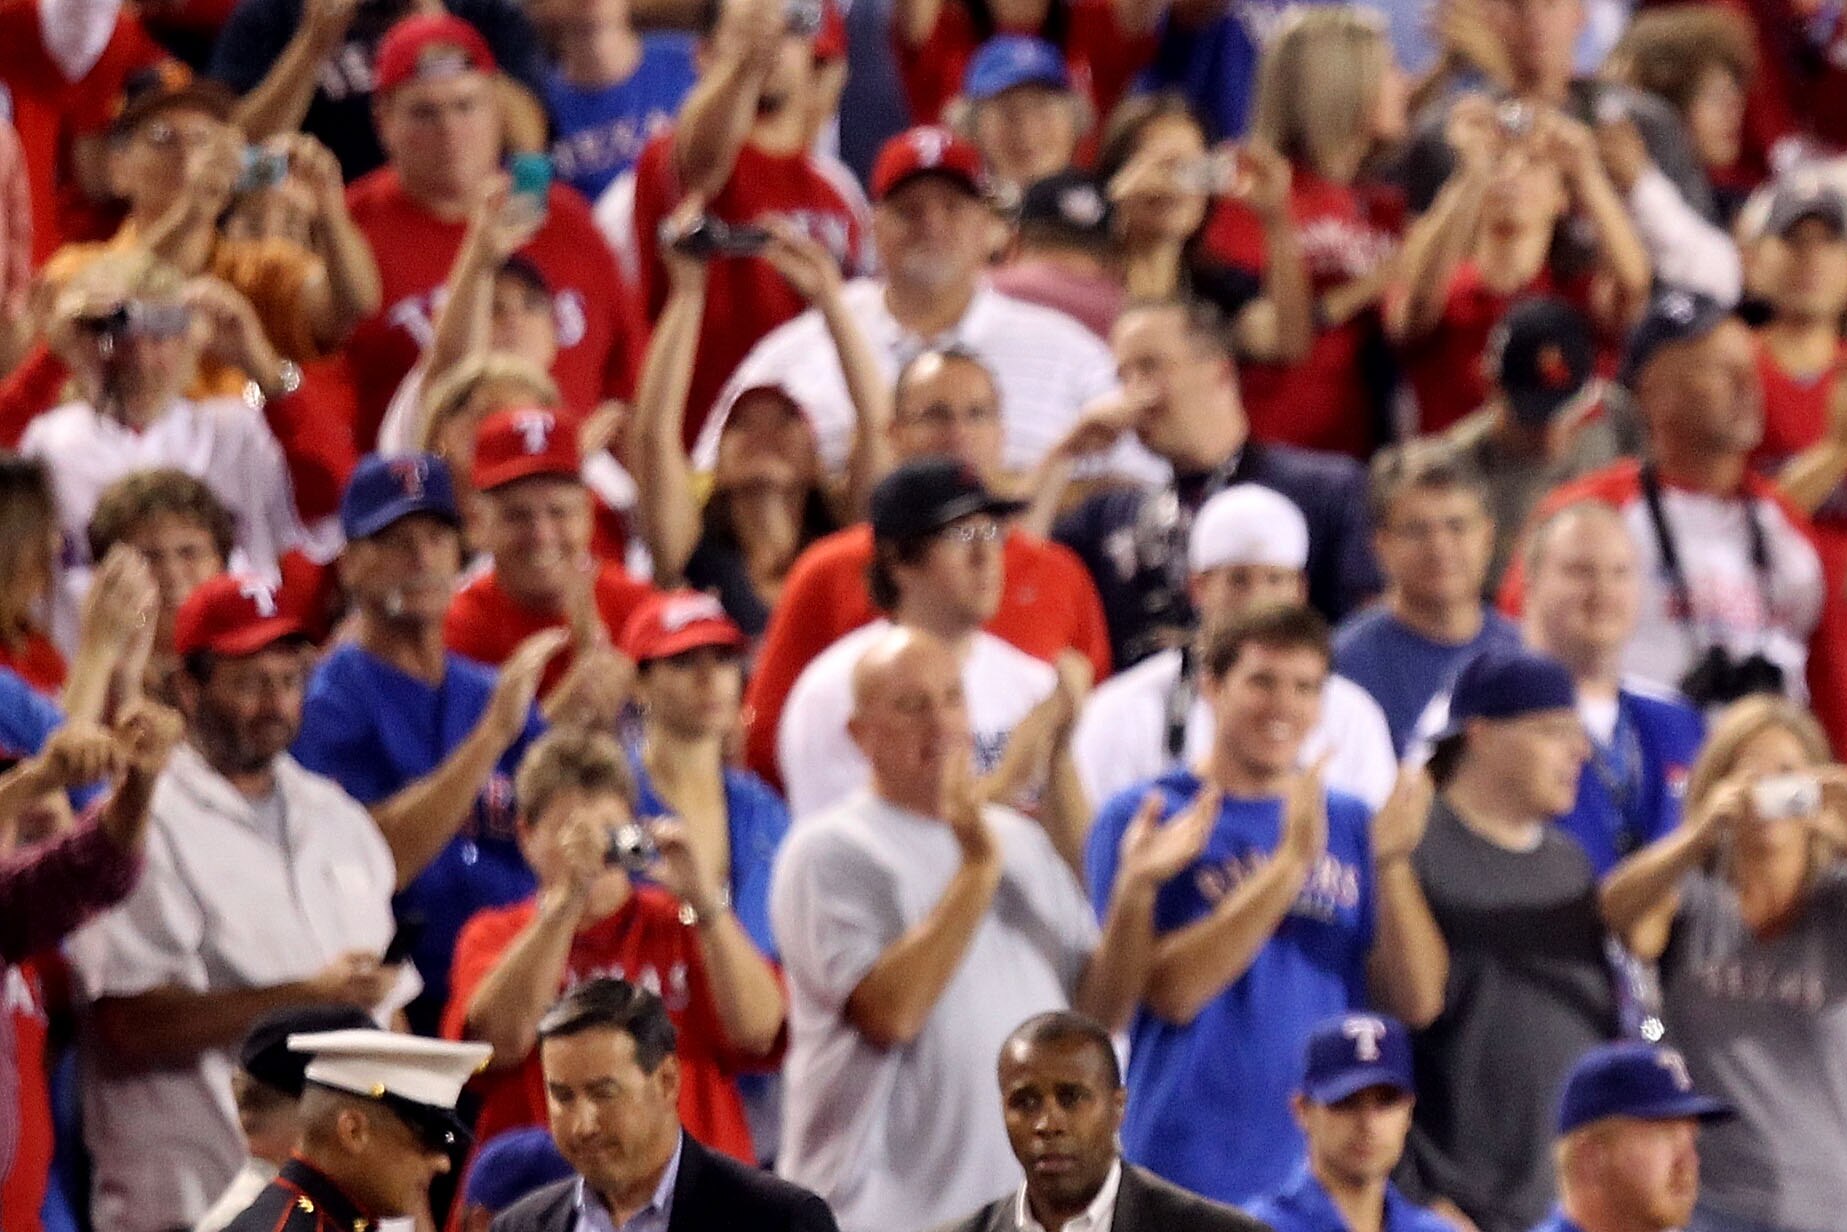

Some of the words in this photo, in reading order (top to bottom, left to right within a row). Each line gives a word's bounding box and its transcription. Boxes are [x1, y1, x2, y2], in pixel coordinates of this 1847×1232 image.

[512, 410, 555, 455] T
[241, 581, 278, 616] T
[1342, 1016, 1387, 1062] T
